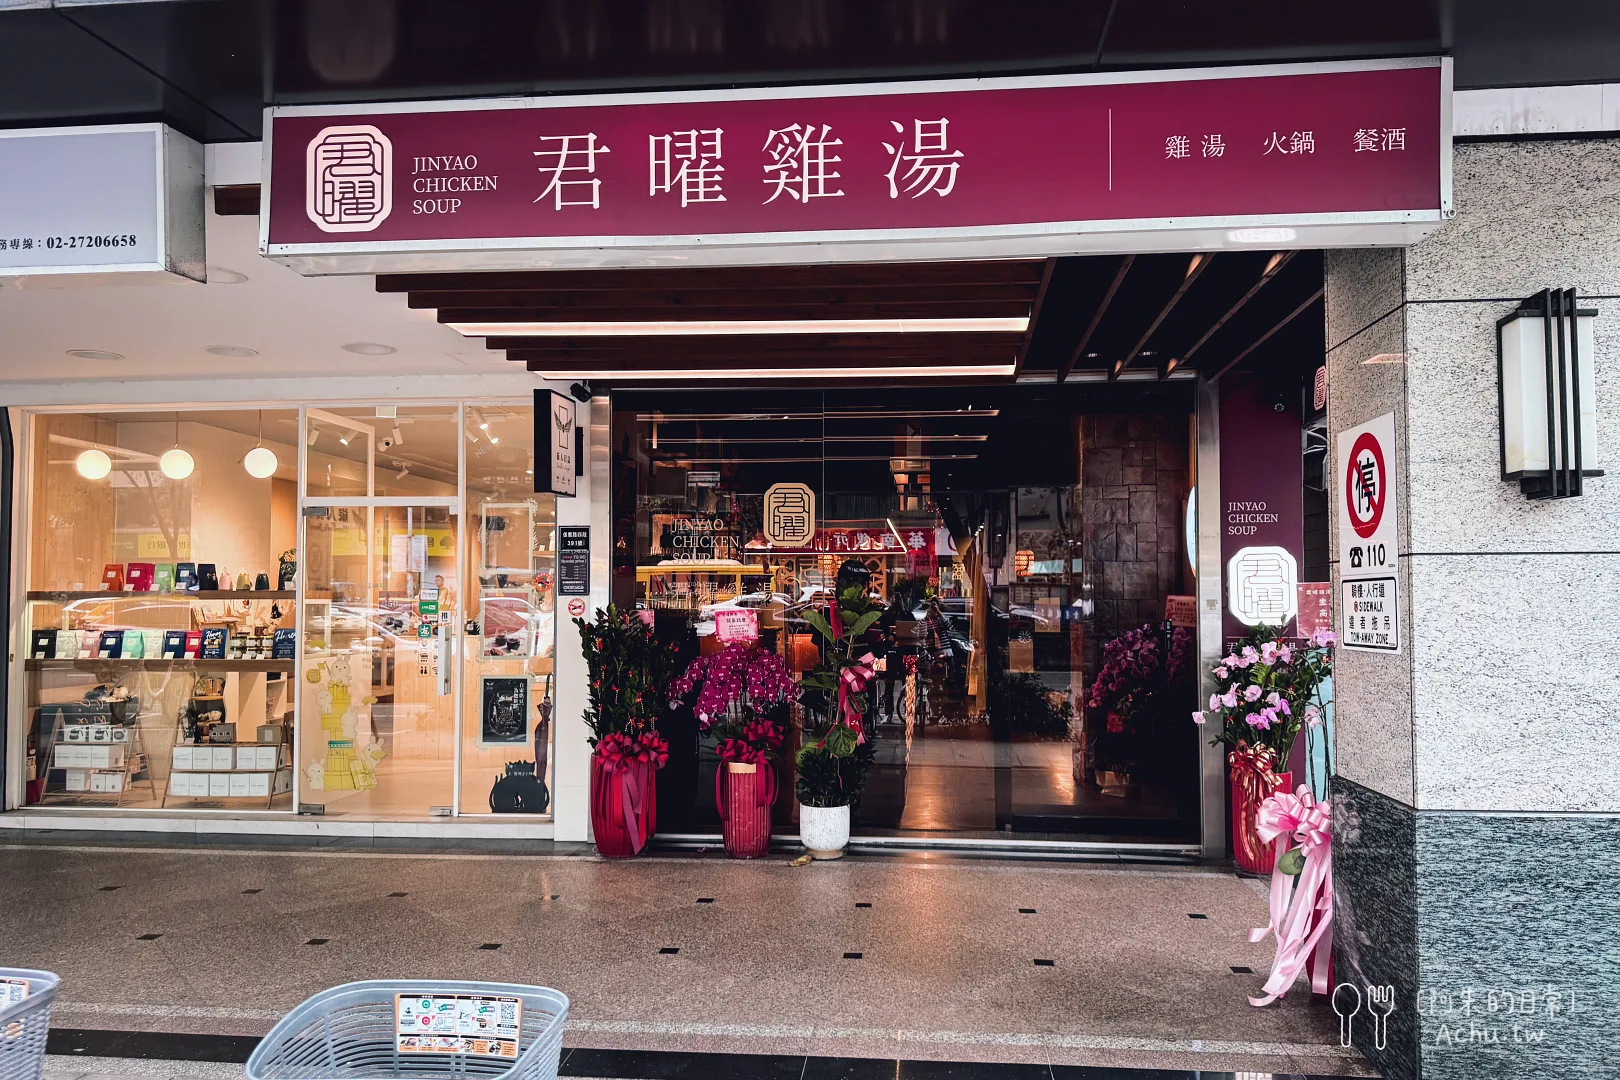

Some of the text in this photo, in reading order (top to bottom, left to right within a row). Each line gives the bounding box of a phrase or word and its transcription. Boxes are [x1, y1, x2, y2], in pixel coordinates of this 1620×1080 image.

[1262, 130, 1316, 156] 火鍋
[1352, 126, 1407, 153] 餐酒
[411, 154, 478, 175] JINYAO
[532, 116, 965, 211] 君曜雞湯
[413, 175, 499, 194] CHICKEN
[412, 198, 462, 215] SOUP
[1355, 457, 1376, 514] 停
[1228, 501, 1267, 513] JINYAO
[671, 519, 724, 533] JINYAO
[1228, 513, 1279, 524] CHICKEN
[1228, 525, 1258, 536] SOUP
[672, 535, 740, 548] CHICKEN
[1367, 543, 1385, 567] 110
[1359, 601, 1383, 612] SIDEWALK
[1375, 634, 1389, 645] ZONE
